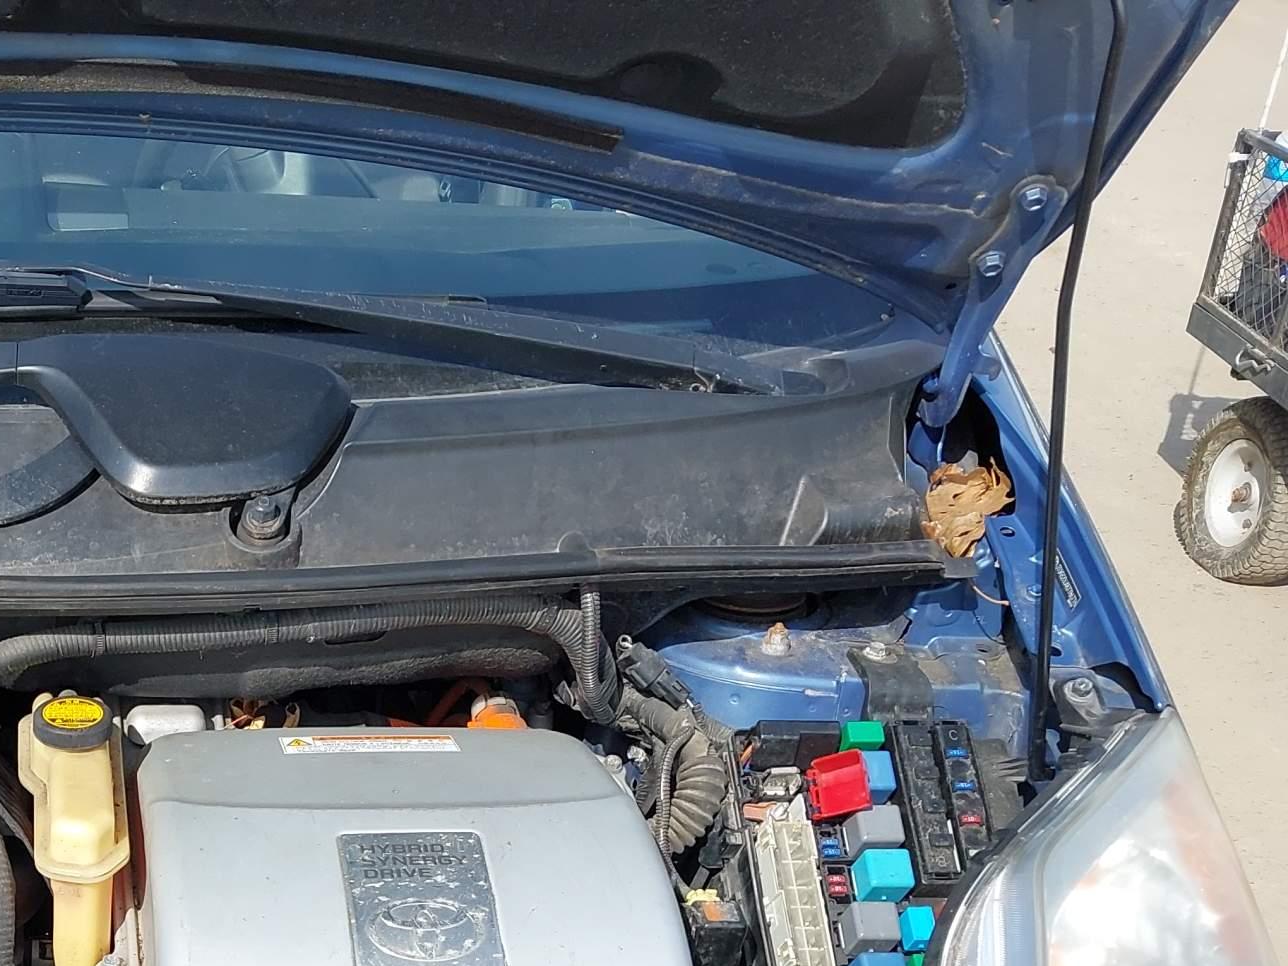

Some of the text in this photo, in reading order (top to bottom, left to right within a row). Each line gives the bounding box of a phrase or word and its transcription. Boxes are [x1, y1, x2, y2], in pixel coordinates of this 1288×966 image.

[948, 729, 959, 741] C
[360, 843, 445, 854] HYBRID
[361, 855, 467, 867] SYNERGY
[364, 867, 433, 879] DRIVE
